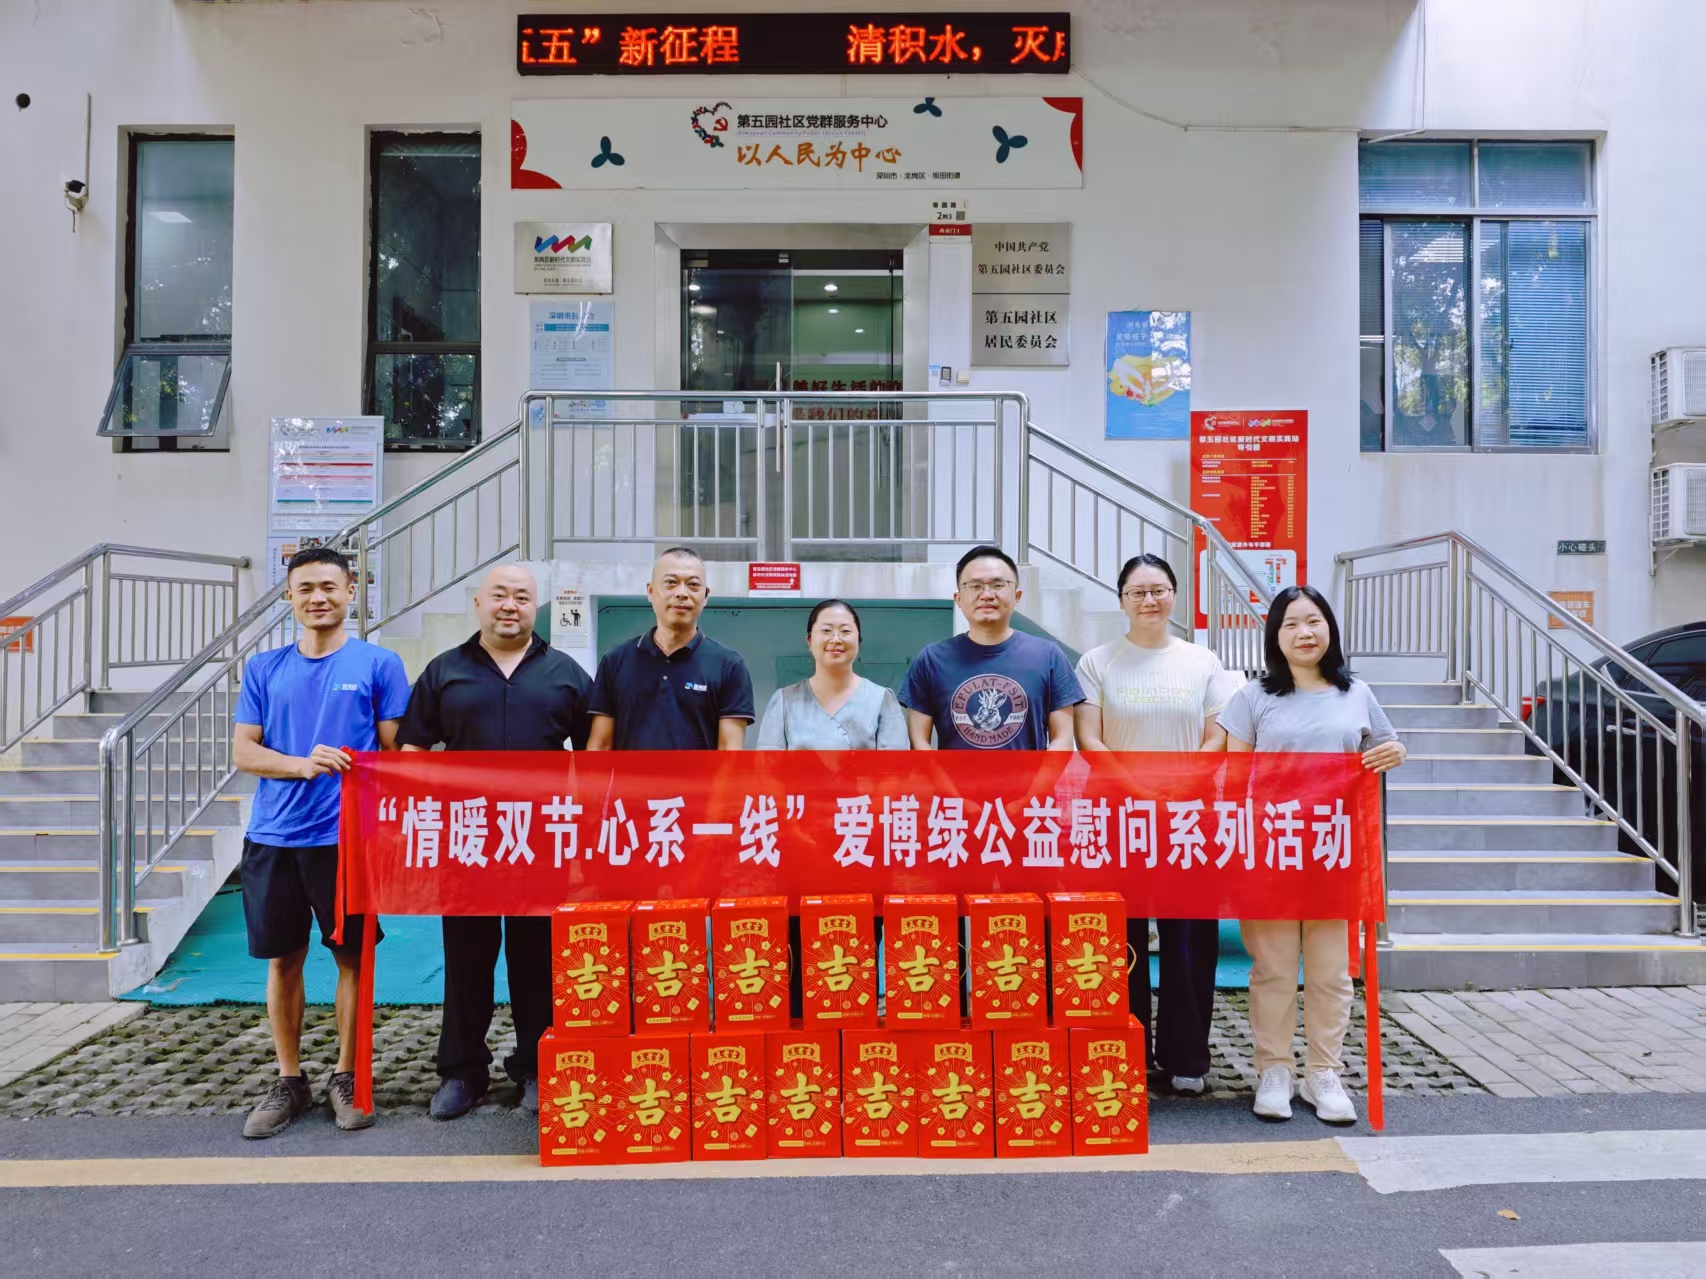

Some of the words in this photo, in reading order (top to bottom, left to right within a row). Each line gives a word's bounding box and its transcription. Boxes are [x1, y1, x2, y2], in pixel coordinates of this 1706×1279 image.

[737, 114, 888, 128] 第五园社区党群服务中心
[737, 141, 902, 172] 以人民为中心
[978, 264, 1065, 274] 第五园社区委员会
[994, 241, 1049, 252] 中国共产党
[985, 310, 1057, 324] 第五园社区
[984, 334, 1057, 348] 居民委员会
[832, 794, 1352, 871] 爱博绿公益慰问系列活动
[567, 953, 608, 1000] 吉
[647, 951, 687, 997] 吉
[729, 948, 769, 994] 吉
[817, 944, 858, 992] 吉
[899, 945, 940, 992] 吉
[987, 944, 1028, 992] 吉
[1067, 942, 1108, 990] 吉
[554, 1080, 595, 1128] 吉
[629, 1078, 670, 1126] 吉
[706, 1076, 746, 1122] 吉
[780, 1073, 822, 1120] 吉
[857, 1072, 898, 1119] 吉
[932, 1072, 973, 1119] 吉
[1010, 1071, 1050, 1119] 吉
[1086, 1070, 1127, 1117] 吉
